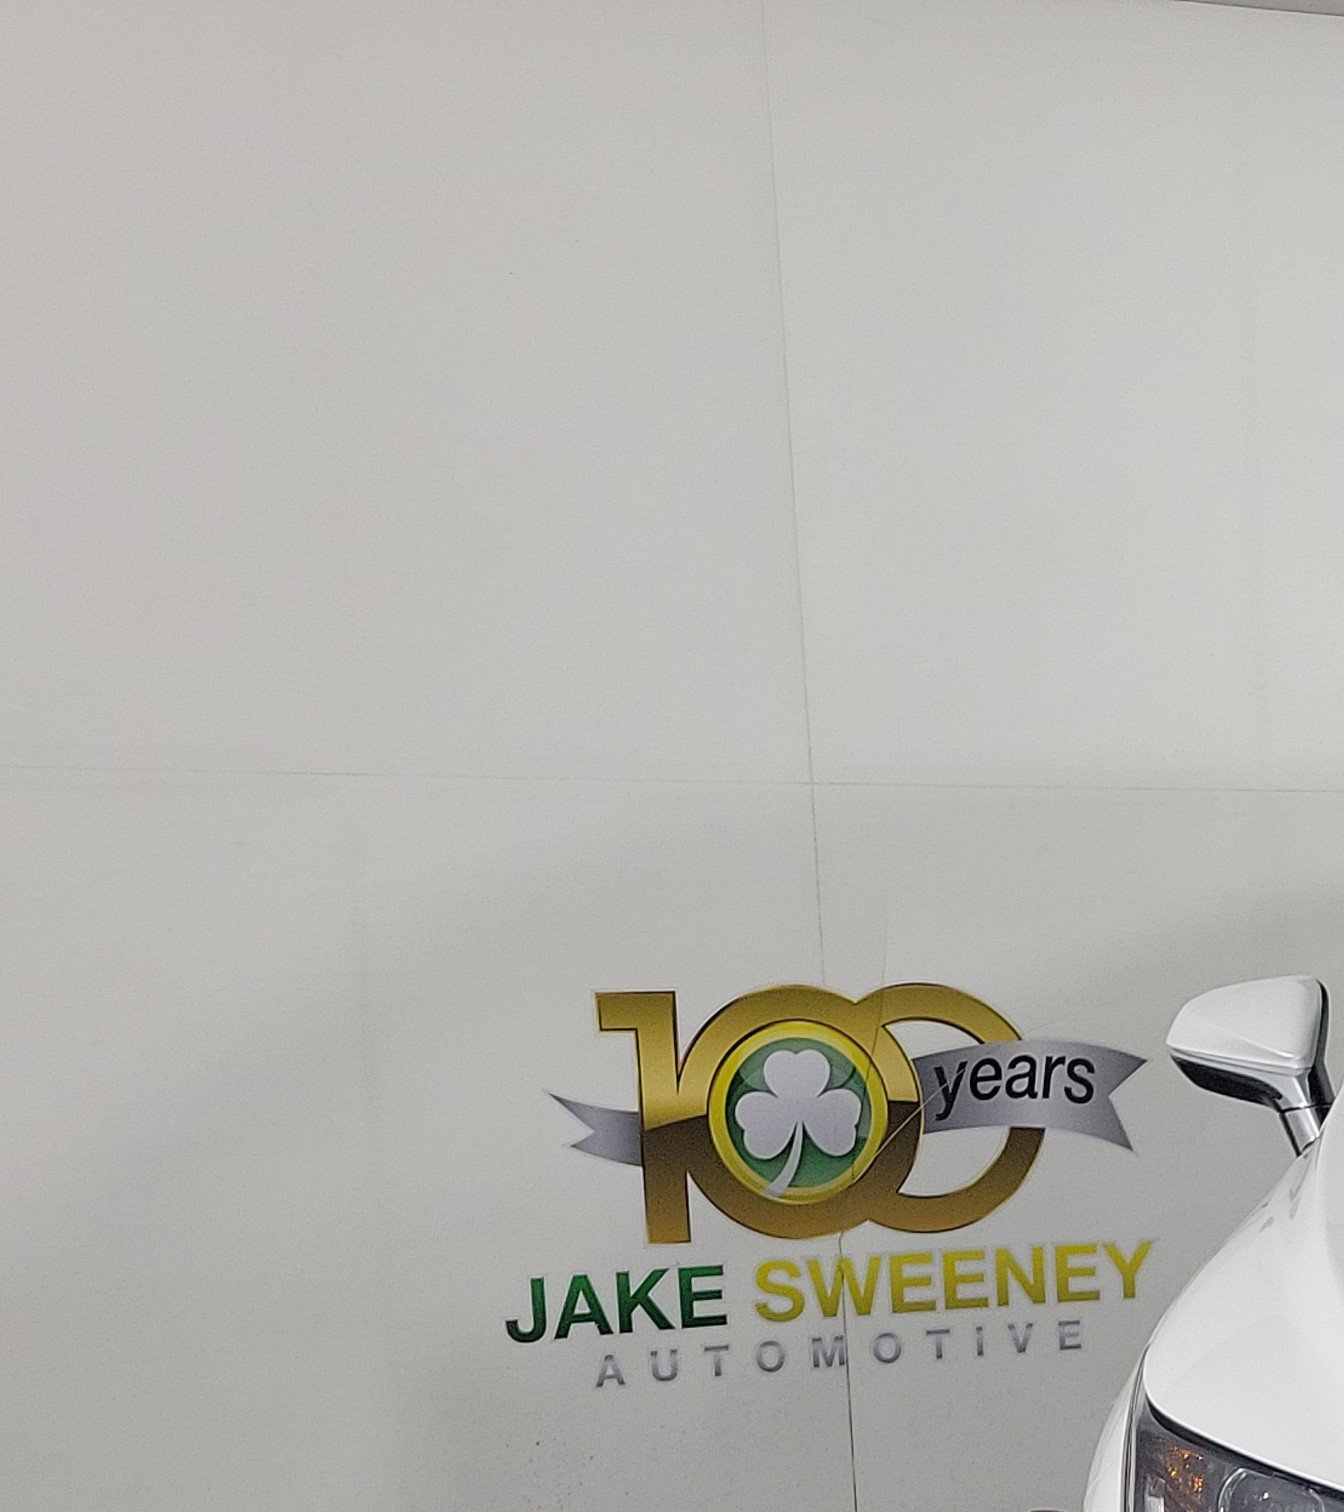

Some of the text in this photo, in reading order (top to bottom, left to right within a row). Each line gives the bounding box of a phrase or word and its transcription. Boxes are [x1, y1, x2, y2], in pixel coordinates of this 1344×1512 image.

[594, 982, 1096, 1244] 100 years
[505, 1240, 1155, 1344] JAKE SWEENEY
[595, 1319, 1083, 1388] AUTOMOTIVE
